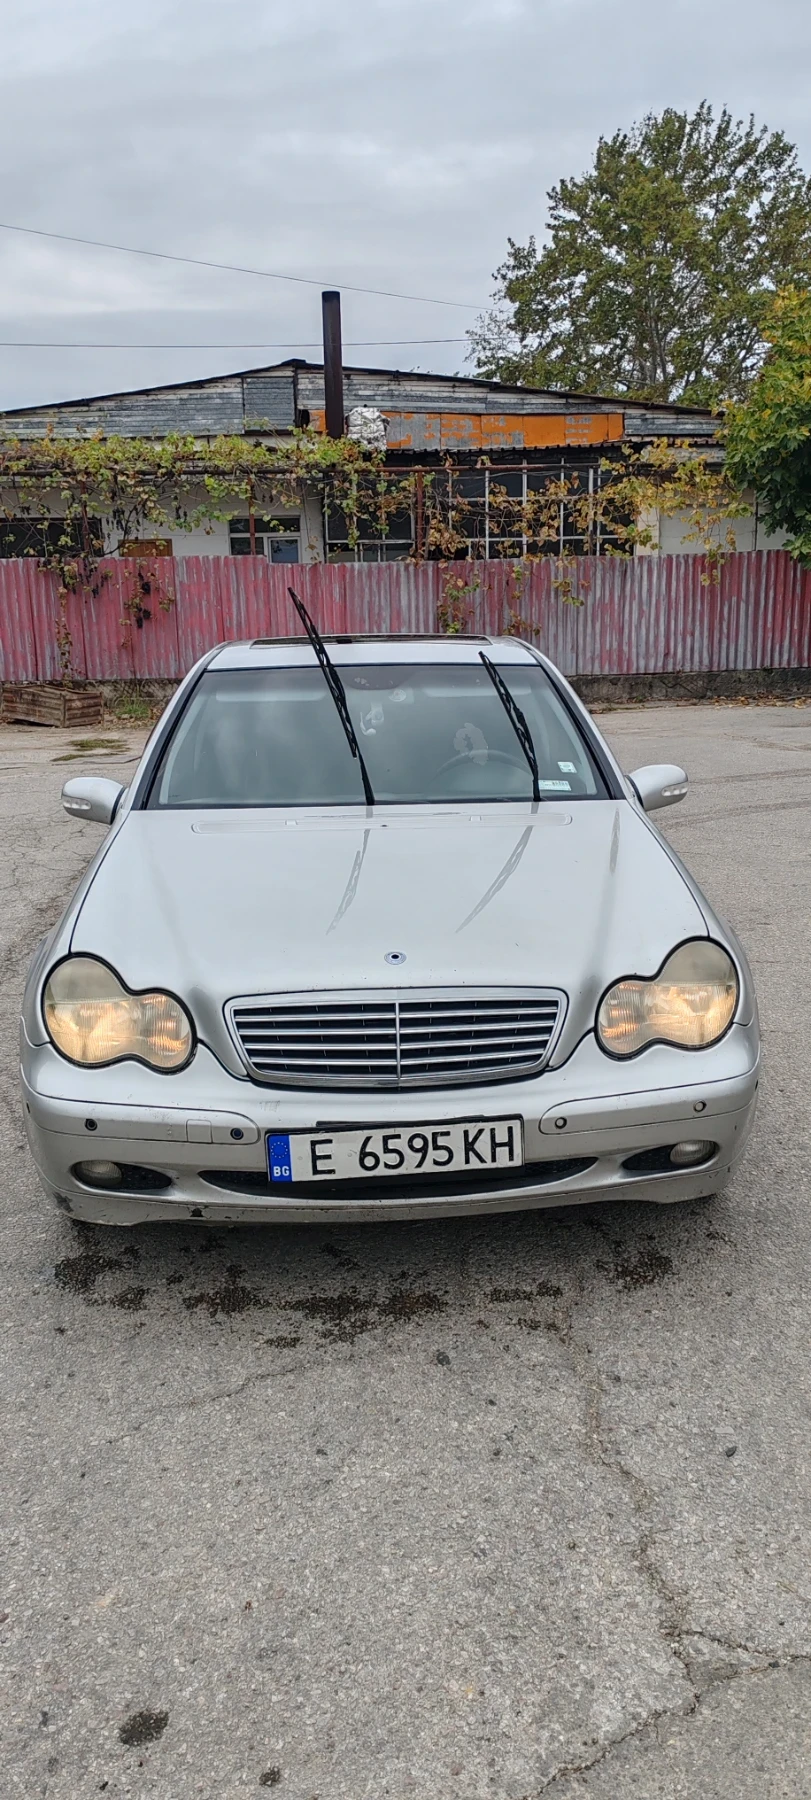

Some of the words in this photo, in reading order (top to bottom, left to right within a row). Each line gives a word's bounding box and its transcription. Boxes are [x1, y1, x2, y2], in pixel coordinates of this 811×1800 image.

[310, 1138, 336, 1176] E
[358, 1130, 454, 1172] 6595
[463, 1125, 515, 1165] KH
[273, 1165, 290, 1177] BG
